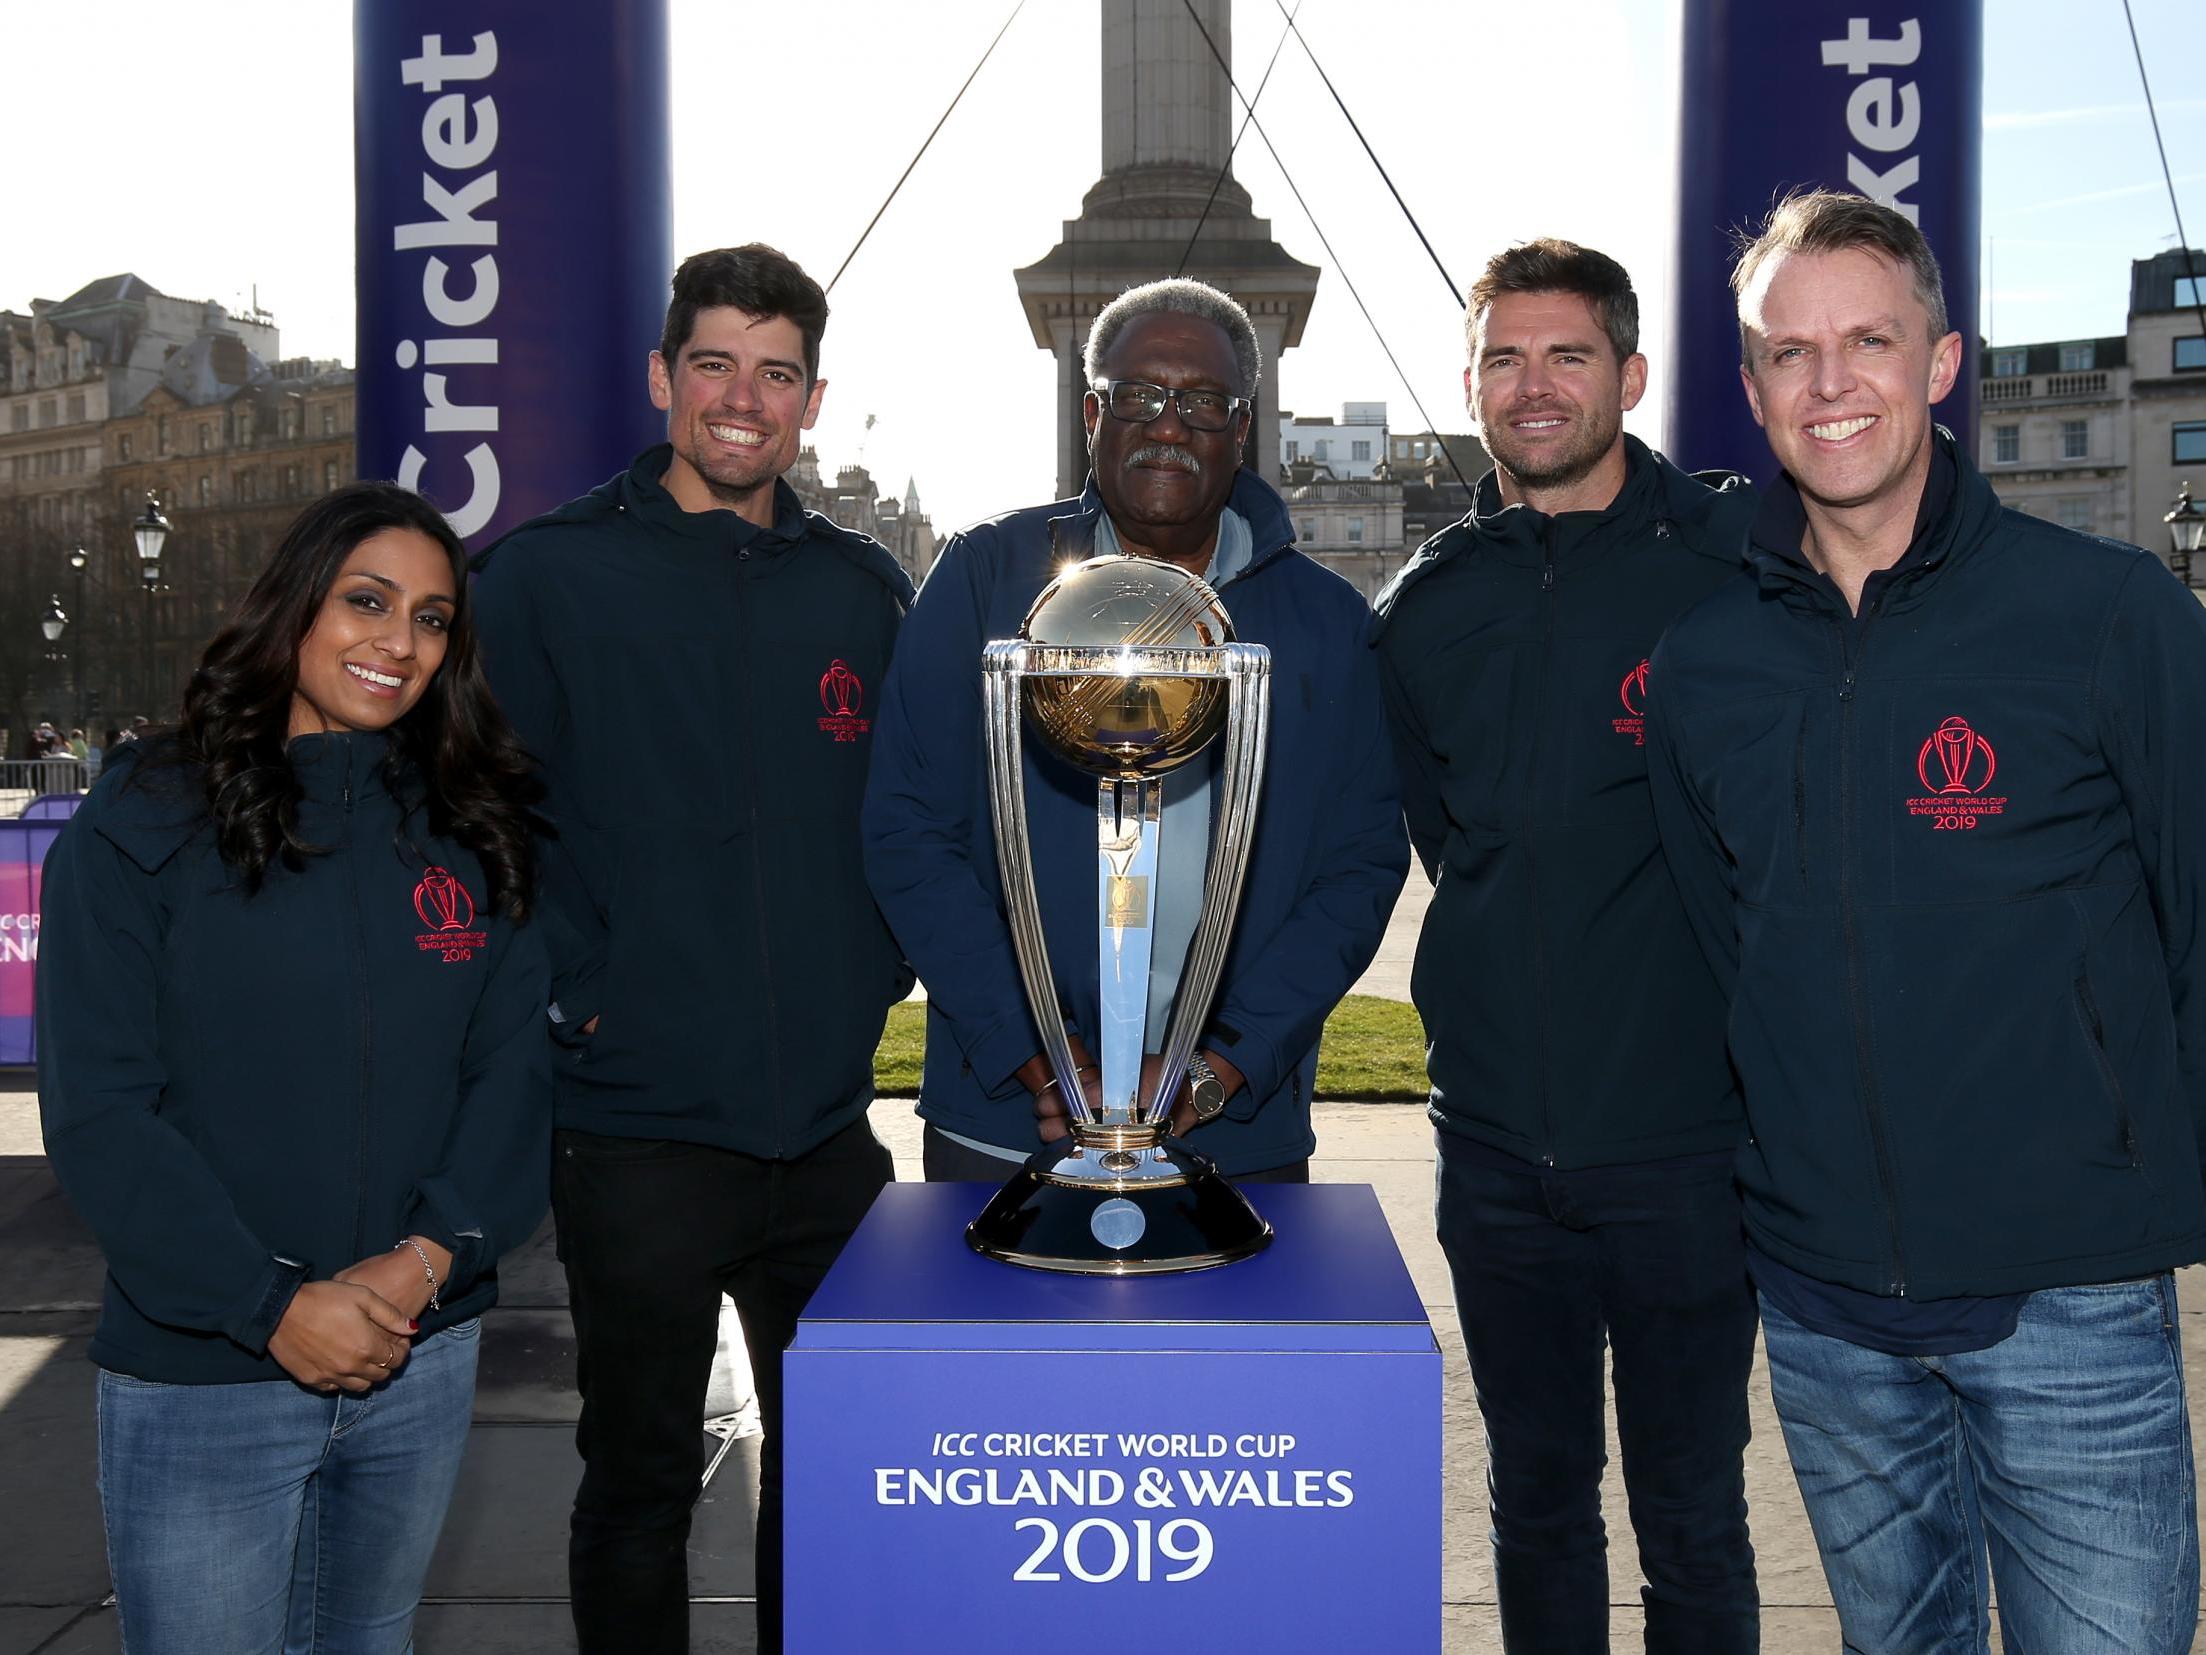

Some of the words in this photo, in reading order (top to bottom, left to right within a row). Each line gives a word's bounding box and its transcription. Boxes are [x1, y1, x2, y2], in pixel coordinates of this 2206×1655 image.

[394, 30, 501, 539] Cricket
[1905, 798, 1919, 807] ICC
[1919, 797, 1955, 806] CRICKET
[1955, 797, 1988, 806] WORLD
[1988, 796, 2008, 805] CUP
[1910, 806, 1958, 815] ENGLAND
[1968, 805, 2003, 815] WALES
[1933, 815, 1977, 830] 2019
[442, 948, 472, 962] 2019
[932, 1433, 978, 1457] ICC
[983, 1433, 1109, 1457] CRICKET
[1117, 1433, 1228, 1458] WORLD
[1235, 1434, 1296, 1458] CUP
[874, 1468, 1125, 1506] ENGLAND
[1178, 1469, 1354, 1508] WALES
[1013, 1517, 1214, 1583] 2019
